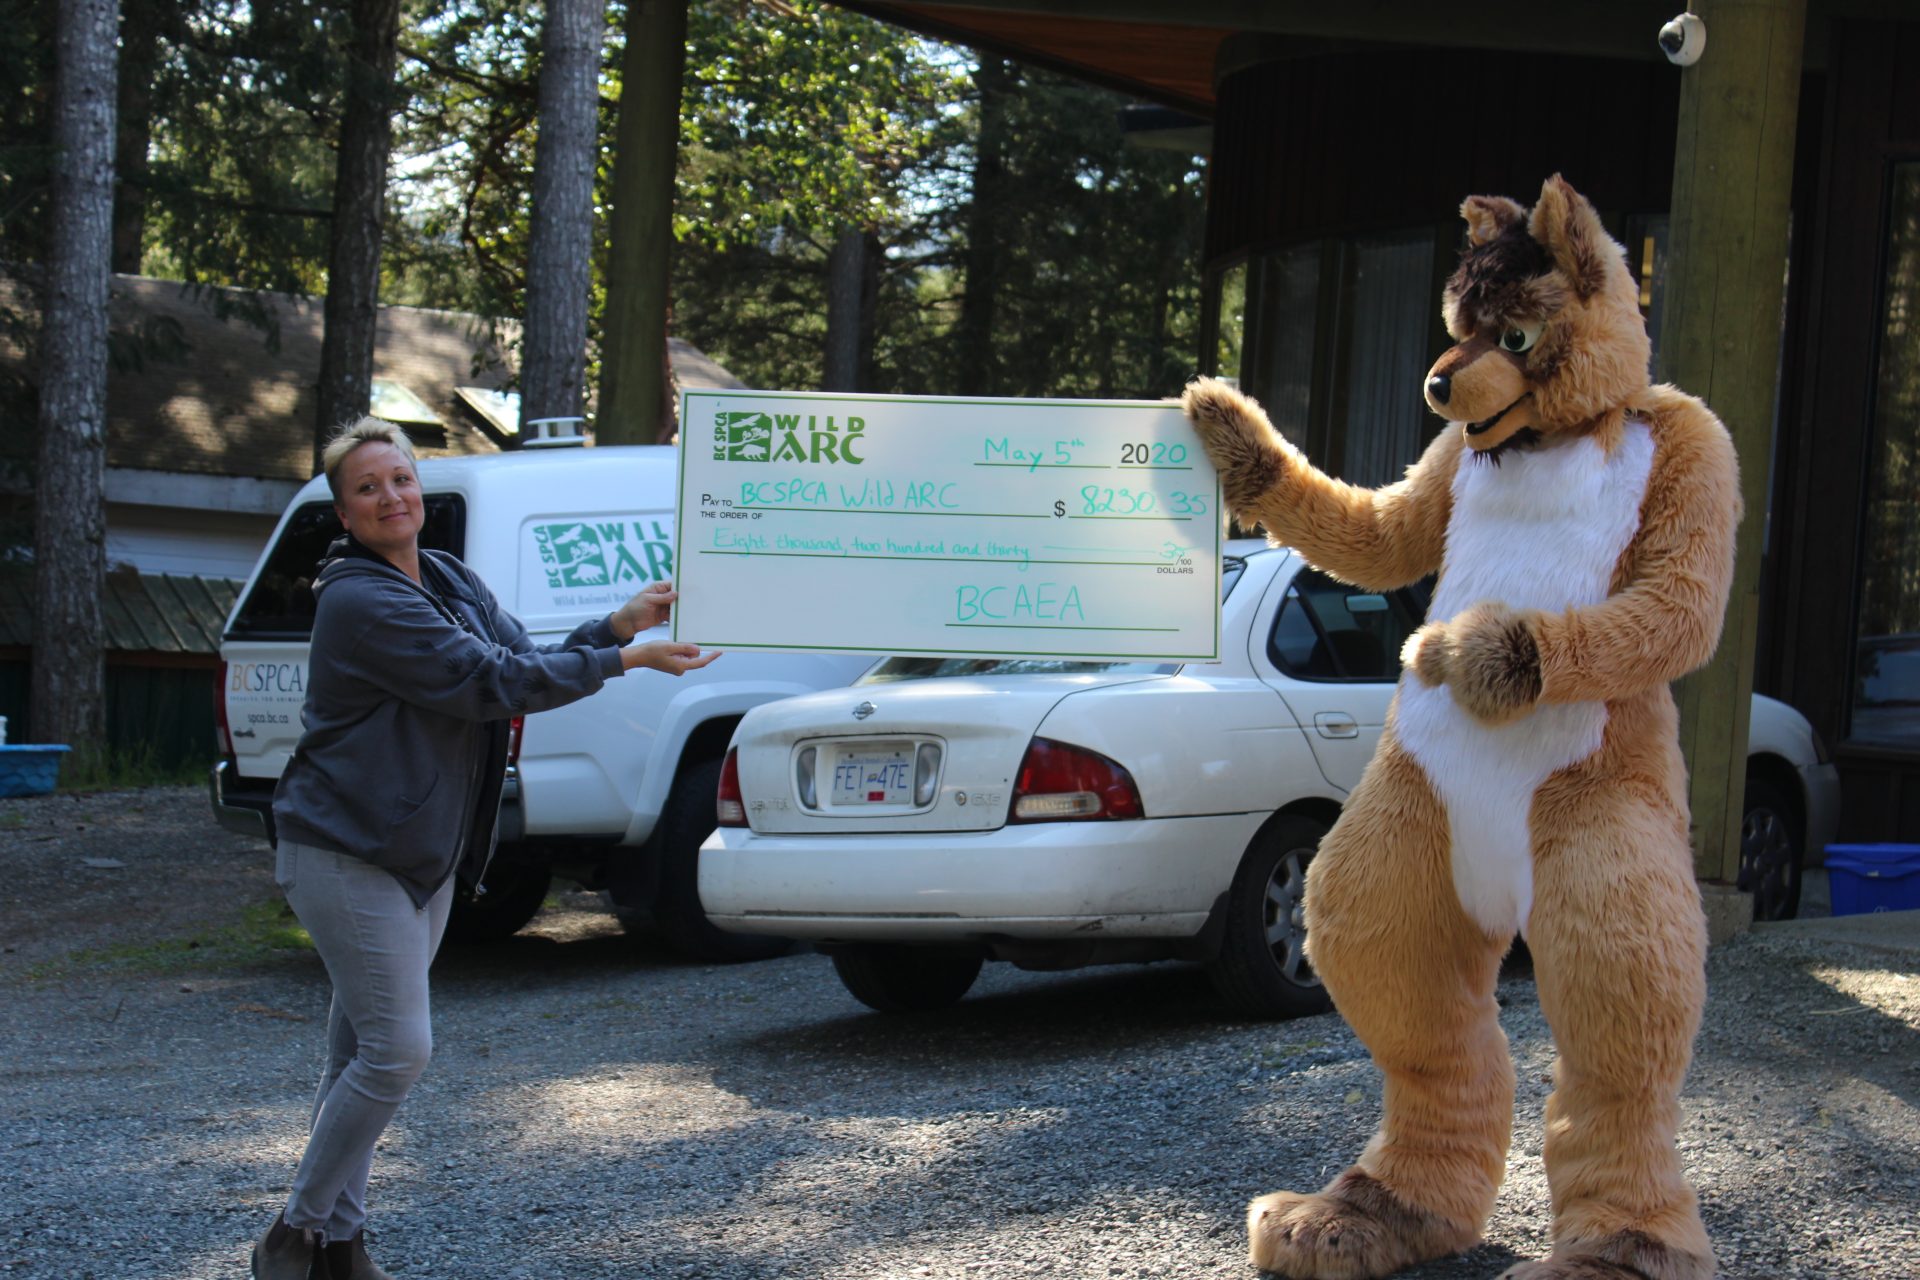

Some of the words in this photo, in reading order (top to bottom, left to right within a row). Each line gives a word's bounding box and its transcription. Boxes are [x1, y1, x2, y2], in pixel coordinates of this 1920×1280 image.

[713, 412, 728, 442] SPCA
[774, 414, 865, 432] WILD
[713, 445, 726, 461] BC
[772, 431, 865, 464] ARC
[984, 438, 1043, 472] May
[1055, 438, 1085, 465] 5th
[1120, 442, 1188, 464] 2020
[741, 478, 828, 505] BCSPCA
[840, 478, 894, 508] Wild
[904, 480, 960, 508] ARC
[700, 511, 717, 519] THE
[719, 512, 748, 520] ORDER
[533, 525, 557, 563] SPCA
[596, 521, 669, 542] WIL
[713, 527, 769, 557] Eight
[776, 534, 848, 557] thousand,
[850, 536, 881, 553] two
[886, 538, 945, 554] hundred
[952, 542, 981, 555] and
[987, 541, 1030, 572] thirty
[545, 568, 562, 588] BC
[956, 582, 1085, 621] BCAEA
[877, 764, 909, 789] 47E
